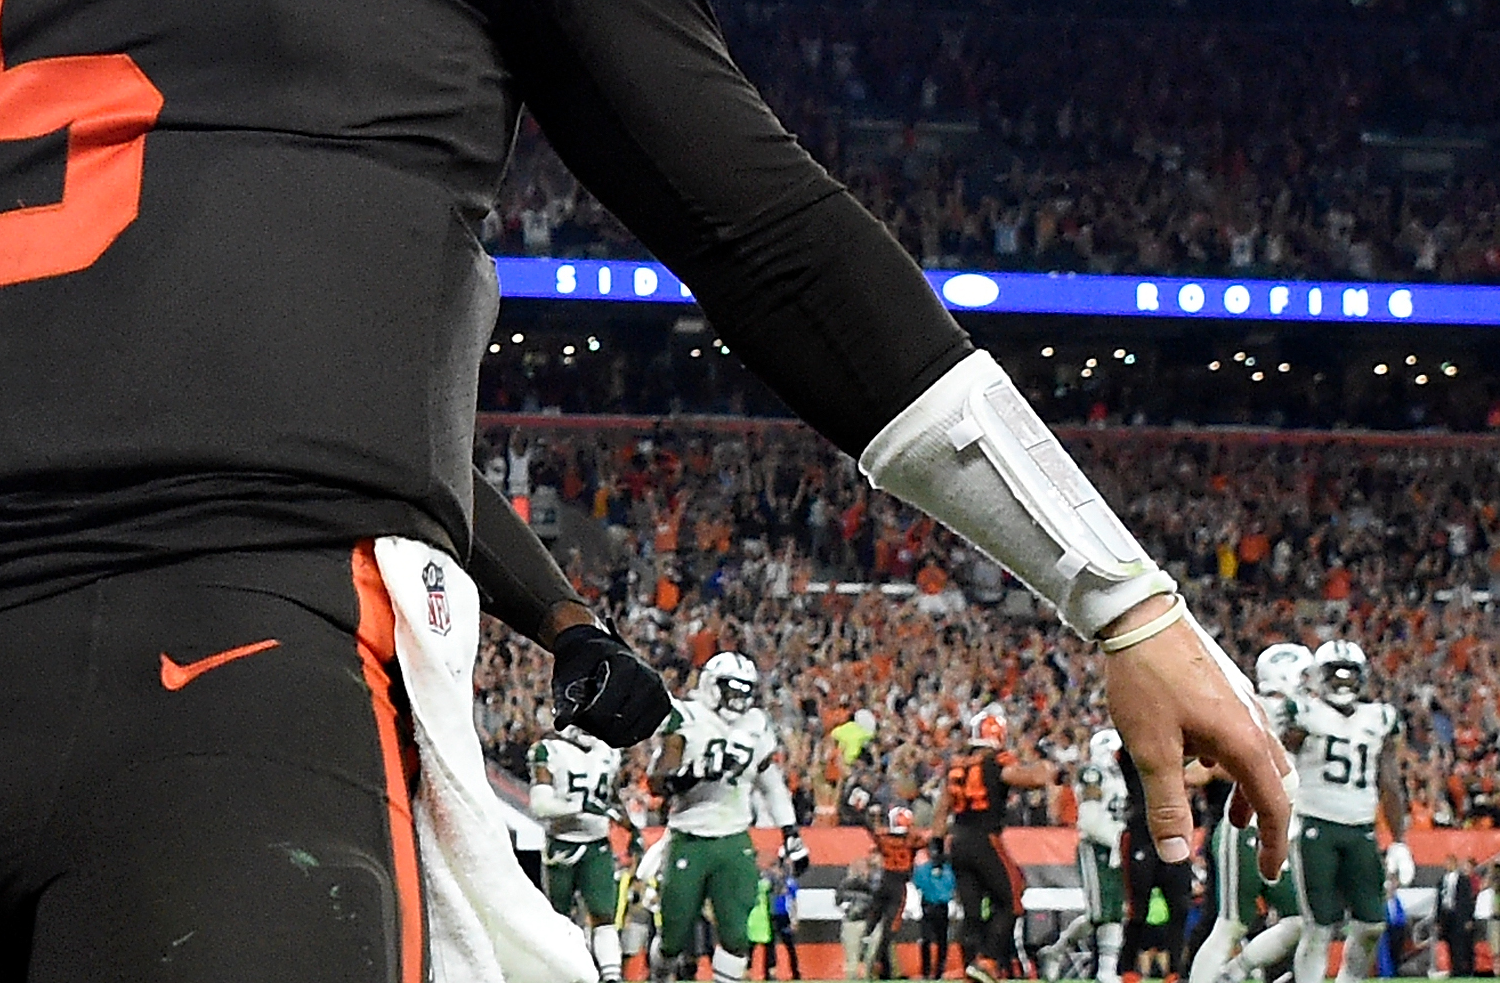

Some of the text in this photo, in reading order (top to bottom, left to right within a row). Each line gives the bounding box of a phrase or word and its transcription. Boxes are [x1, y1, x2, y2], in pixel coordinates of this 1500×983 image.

[1136, 281, 1413, 317] ROOFING
[428, 593, 451, 630] NFL
[1323, 734, 1368, 789] 51
